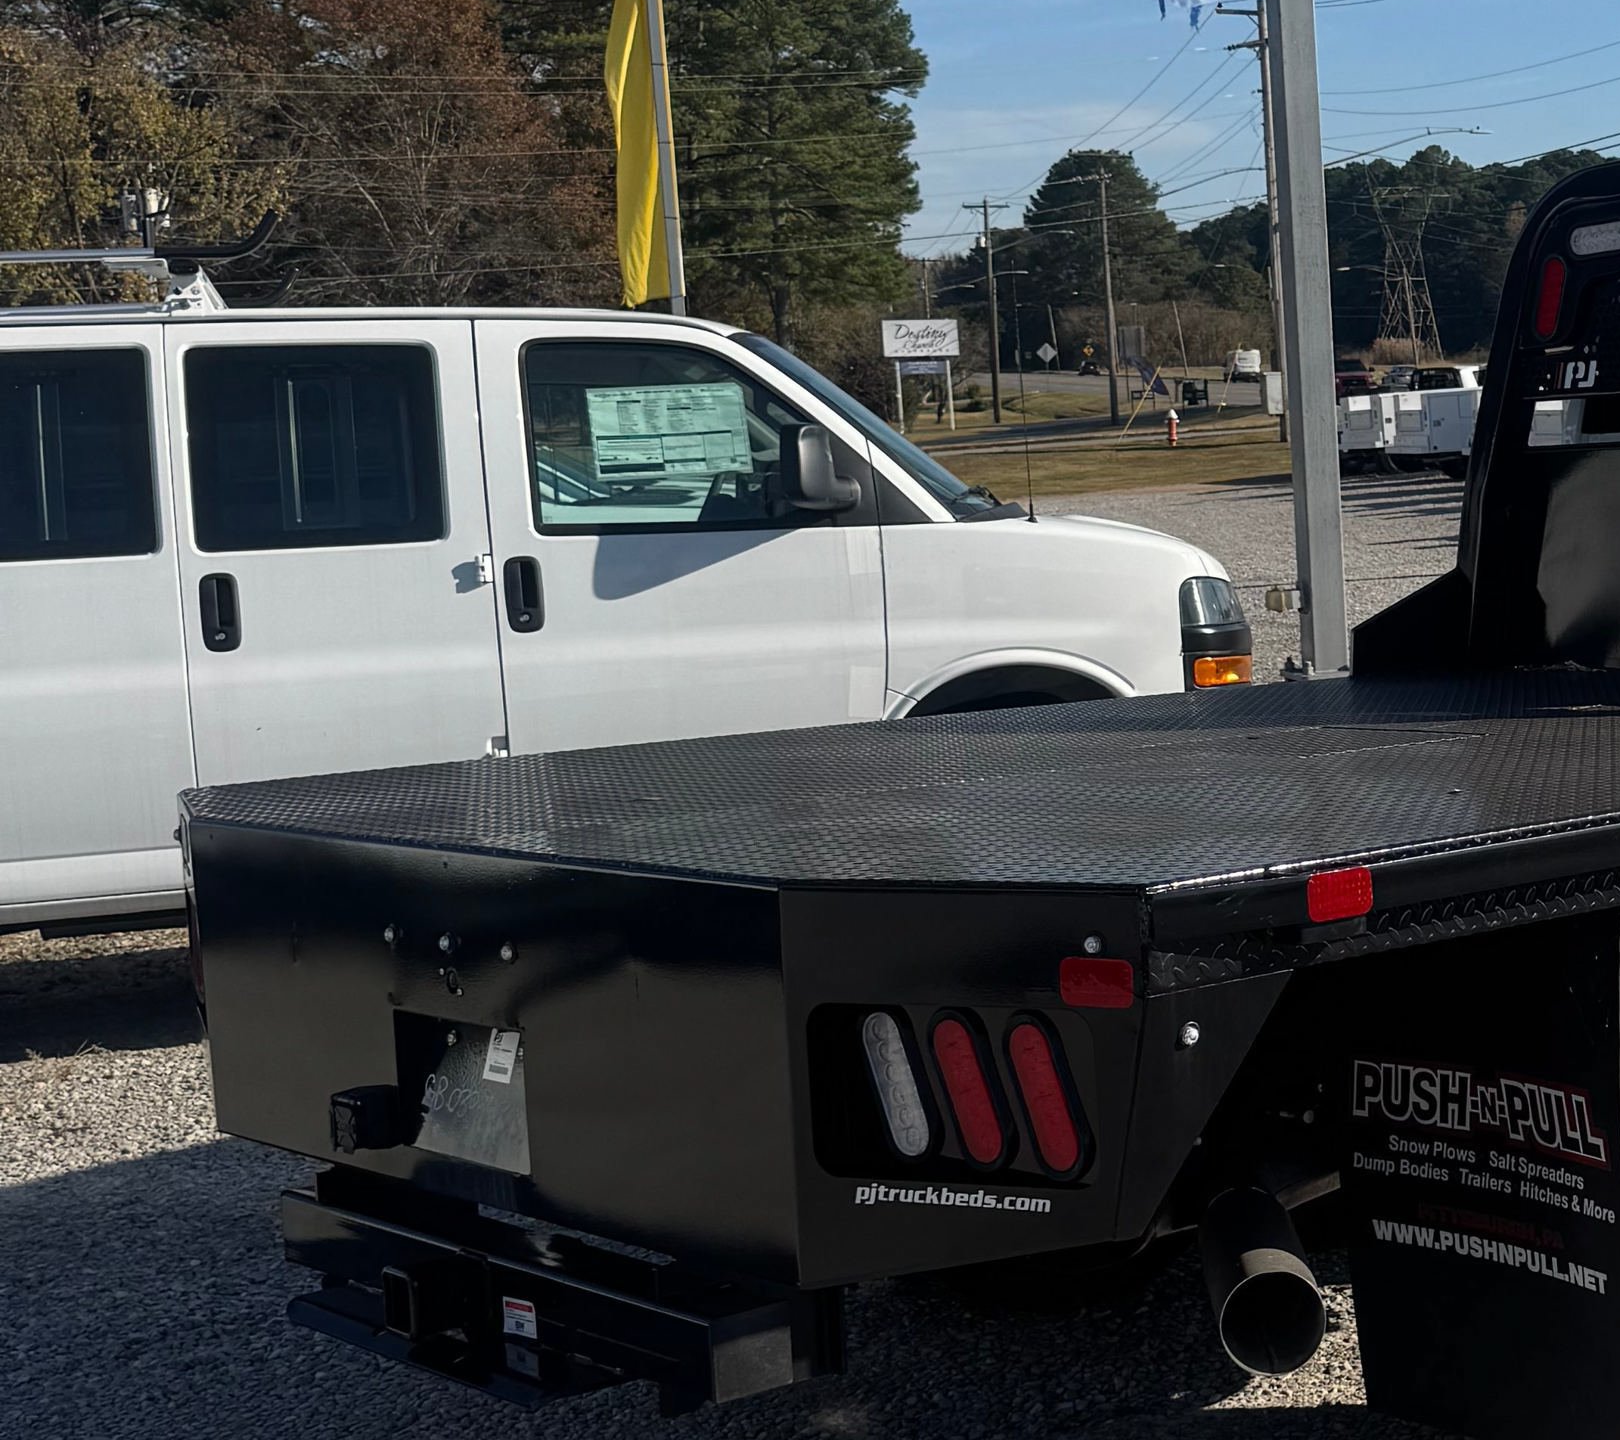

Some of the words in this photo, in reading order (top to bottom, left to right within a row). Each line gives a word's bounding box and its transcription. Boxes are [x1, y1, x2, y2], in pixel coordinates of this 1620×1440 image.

[894, 323, 947, 345] Destiny
[1564, 359, 1597, 389] PJ
[1352, 1059, 1607, 1163] PUSH-N-PULL
[1353, 1151, 1396, 1176] Dump
[1399, 1158, 1449, 1182] Bodies
[1458, 1167, 1512, 1194] Trailers
[1519, 1180, 1569, 1209] Hitches
[1571, 1194, 1581, 1213] &
[1583, 1198, 1616, 1224] More
[1388, 1135, 1429, 1155] Snow
[1433, 1141, 1476, 1164] Plows
[1489, 1150, 1516, 1171] Salt
[1518, 1157, 1585, 1190] Spreaders
[854, 1182, 1051, 1213] pjtruckbeds.com
[1371, 1219, 1608, 1295] WWW.PUSHNPULL.NET
